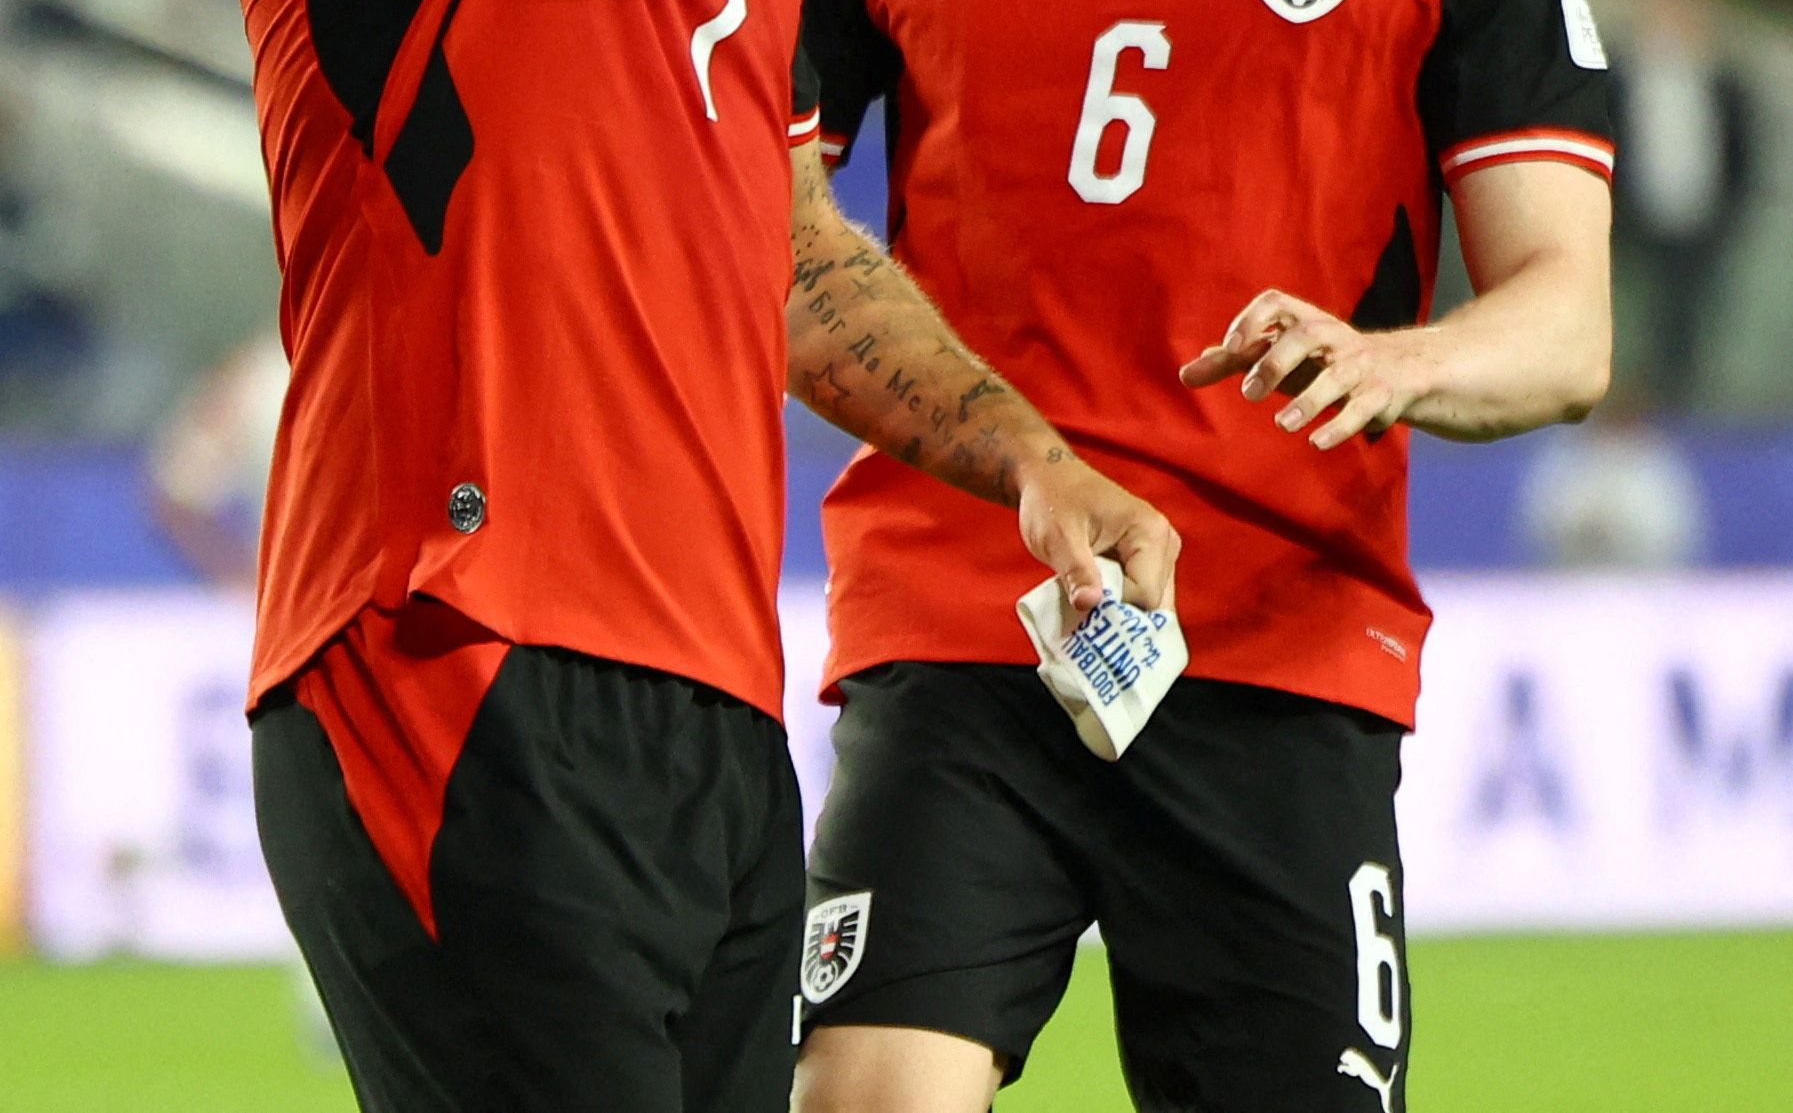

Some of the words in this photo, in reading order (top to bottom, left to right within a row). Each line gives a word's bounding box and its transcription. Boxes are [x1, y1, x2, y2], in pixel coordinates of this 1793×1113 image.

[1067, 20, 1172, 204] 6
[1061, 630, 1120, 707] FOOTBALL
[1078, 606, 1141, 691] UNITES
[1348, 860, 1400, 1050] 6
